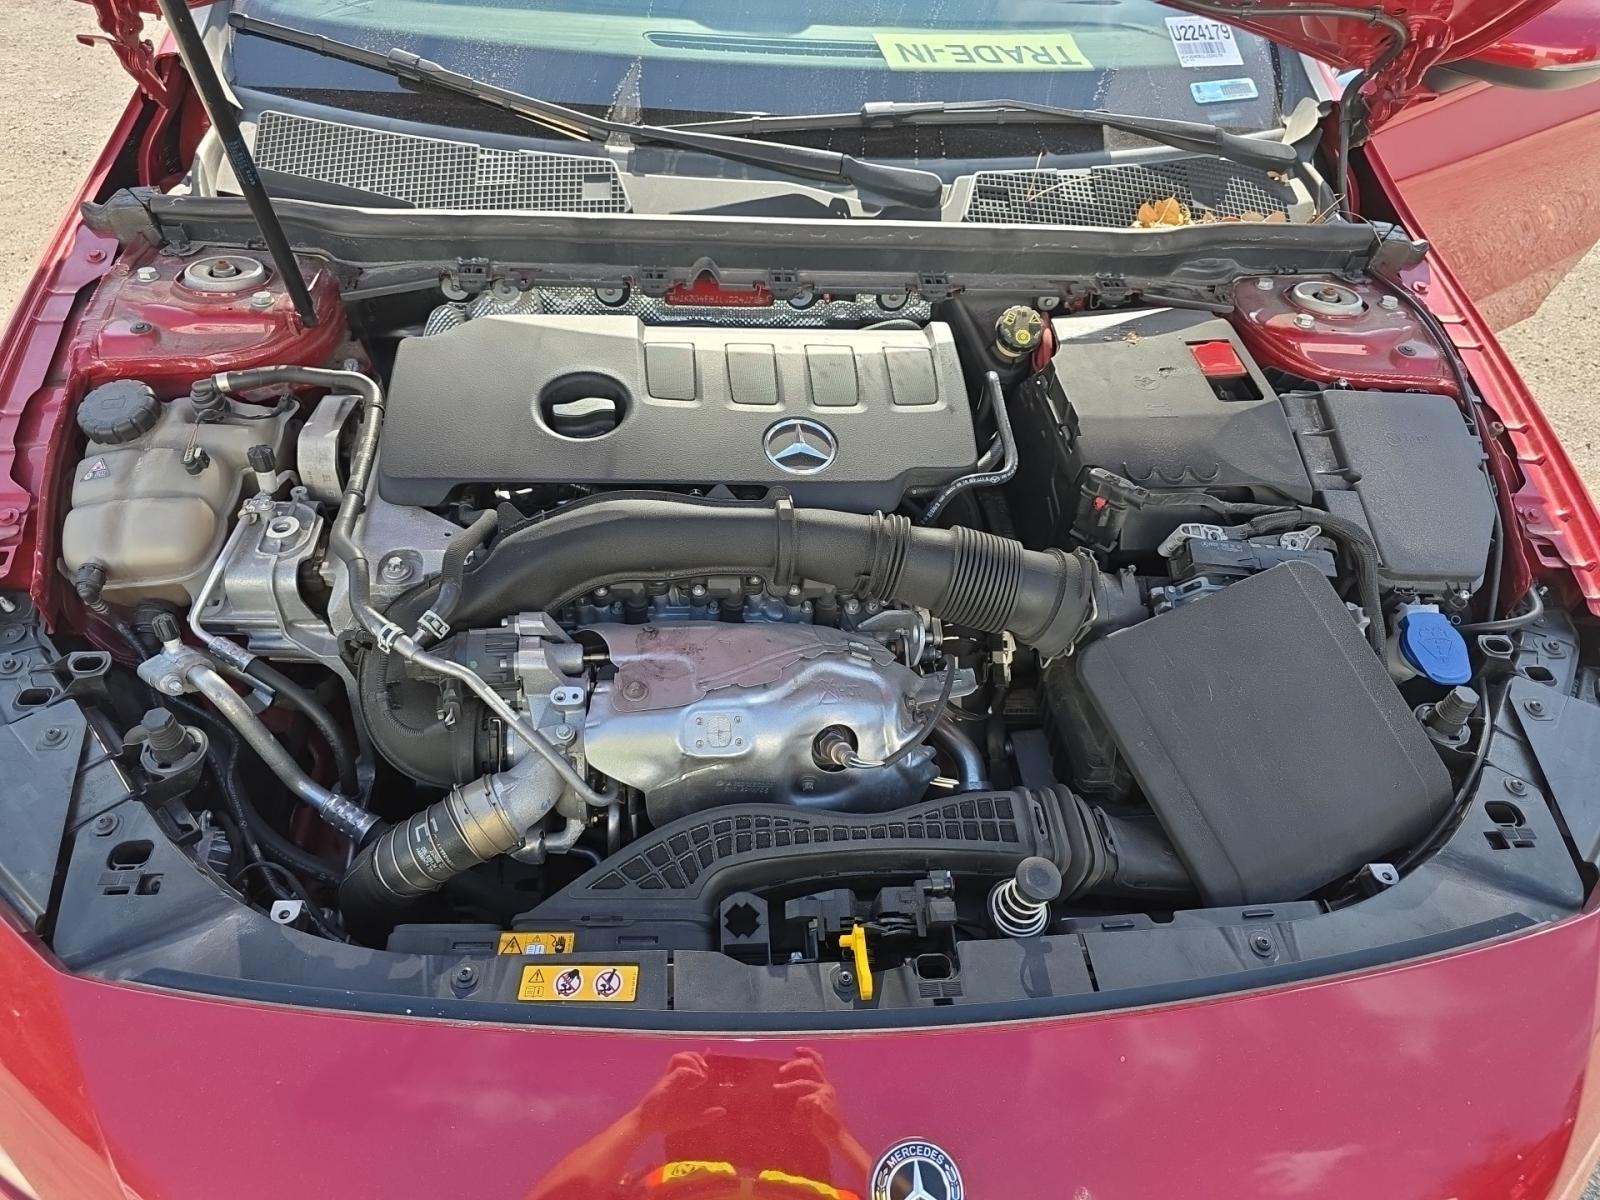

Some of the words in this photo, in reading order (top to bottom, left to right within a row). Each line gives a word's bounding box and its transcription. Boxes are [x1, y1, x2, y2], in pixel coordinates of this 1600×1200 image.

[1170, 24, 1231, 41] U224179
[894, 42, 1082, 65] TRADE-IN
[886, 1145, 945, 1168] MERCEDES
